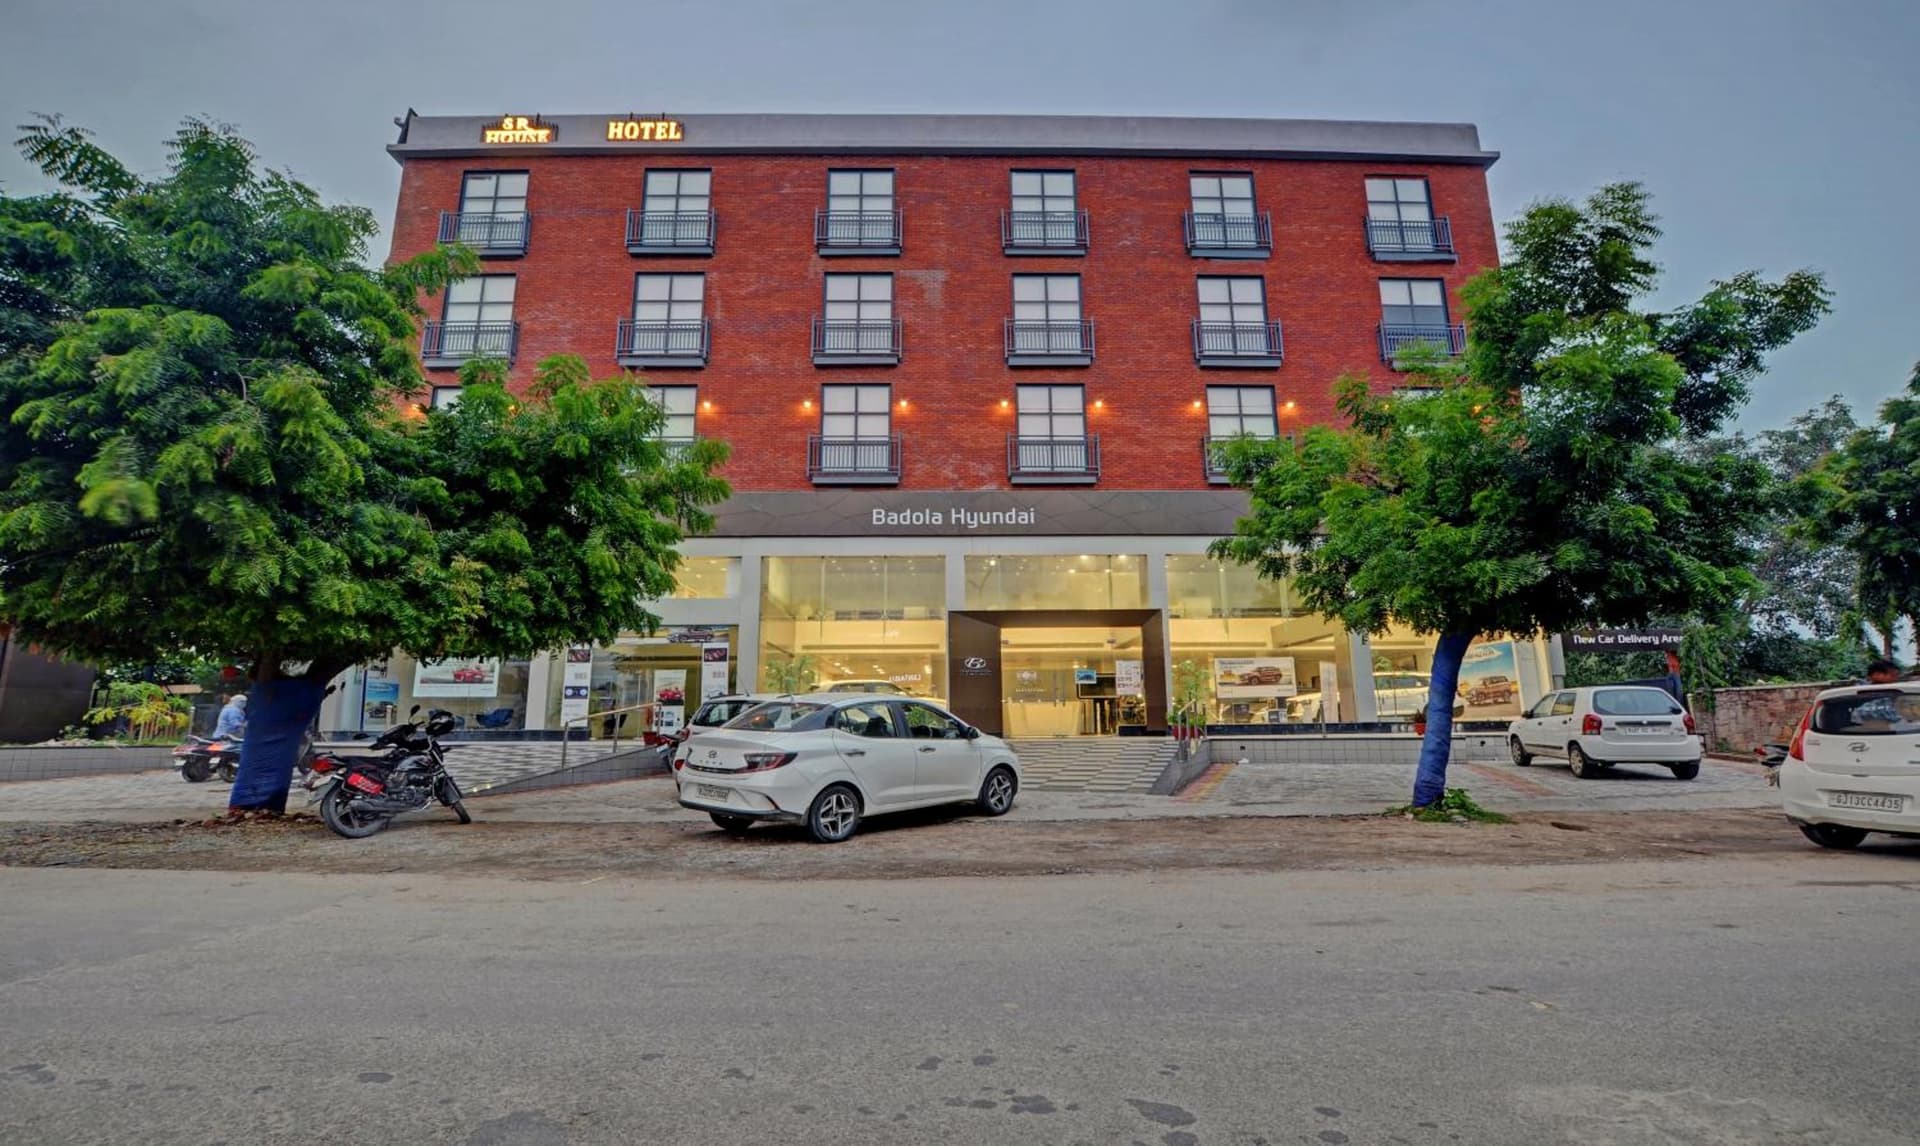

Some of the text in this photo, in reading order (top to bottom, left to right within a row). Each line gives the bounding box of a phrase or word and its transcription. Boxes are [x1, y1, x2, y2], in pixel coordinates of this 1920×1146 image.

[607, 121, 682, 140] HOTEL
[872, 507, 1035, 529] Badola Hyundai
[1573, 634, 1596, 645] New
[1598, 634, 1615, 644] Car
[1617, 634, 1660, 645] Delivery
